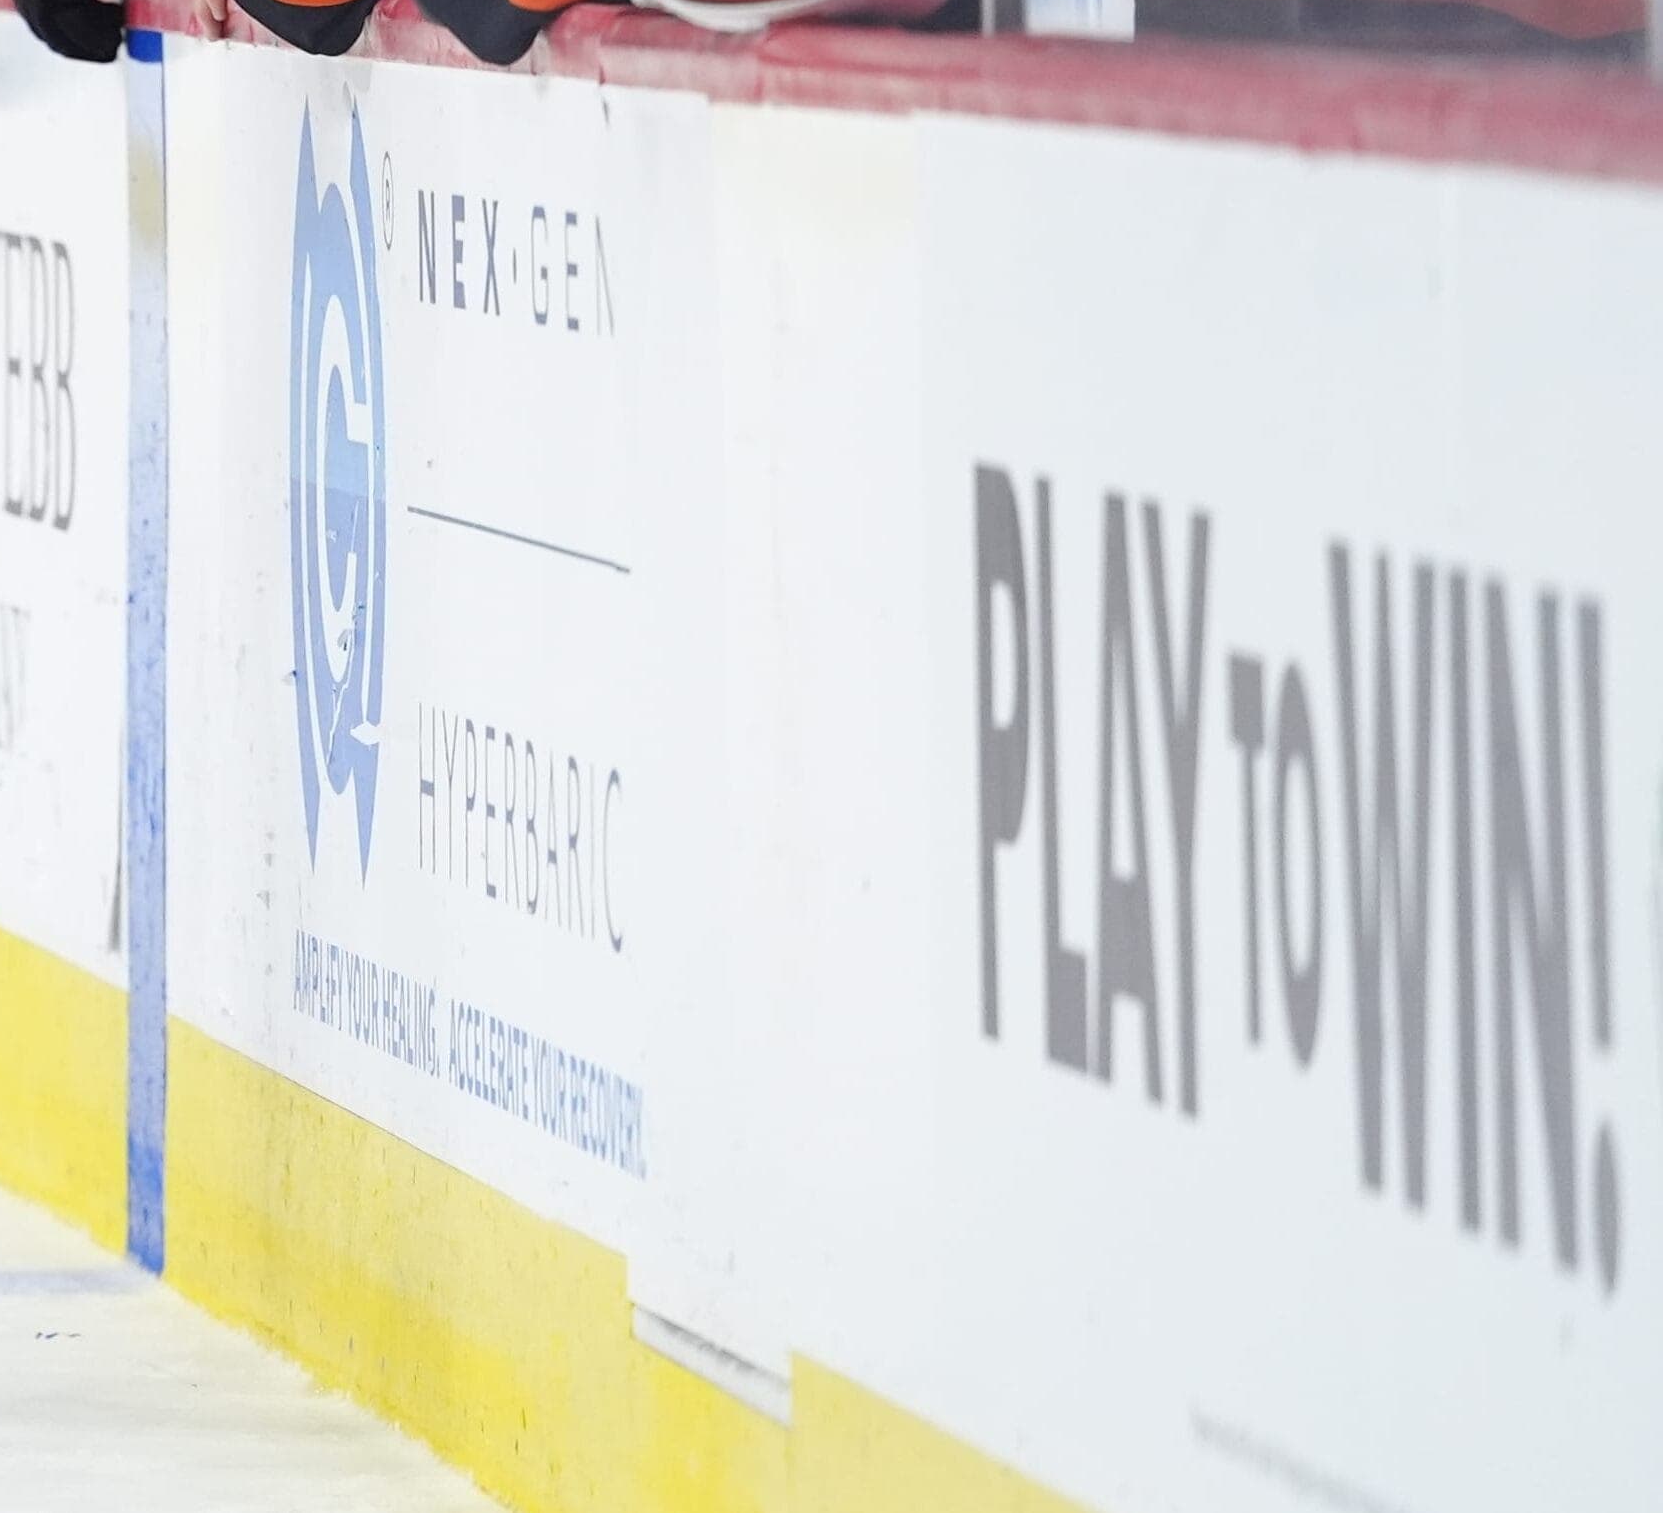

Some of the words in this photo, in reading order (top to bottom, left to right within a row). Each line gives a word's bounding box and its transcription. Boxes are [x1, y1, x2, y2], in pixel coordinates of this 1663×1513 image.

[418, 701, 625, 954] HYPERBARIC
[974, 457, 1210, 1124] PLAY
[1330, 534, 1622, 1304] WIN!
[293, 927, 344, 1032] AMPLIFY
[344, 950, 379, 1050] YOUR
[448, 997, 529, 1122] ACCELERATE
[530, 1034, 568, 1143] YOUR
